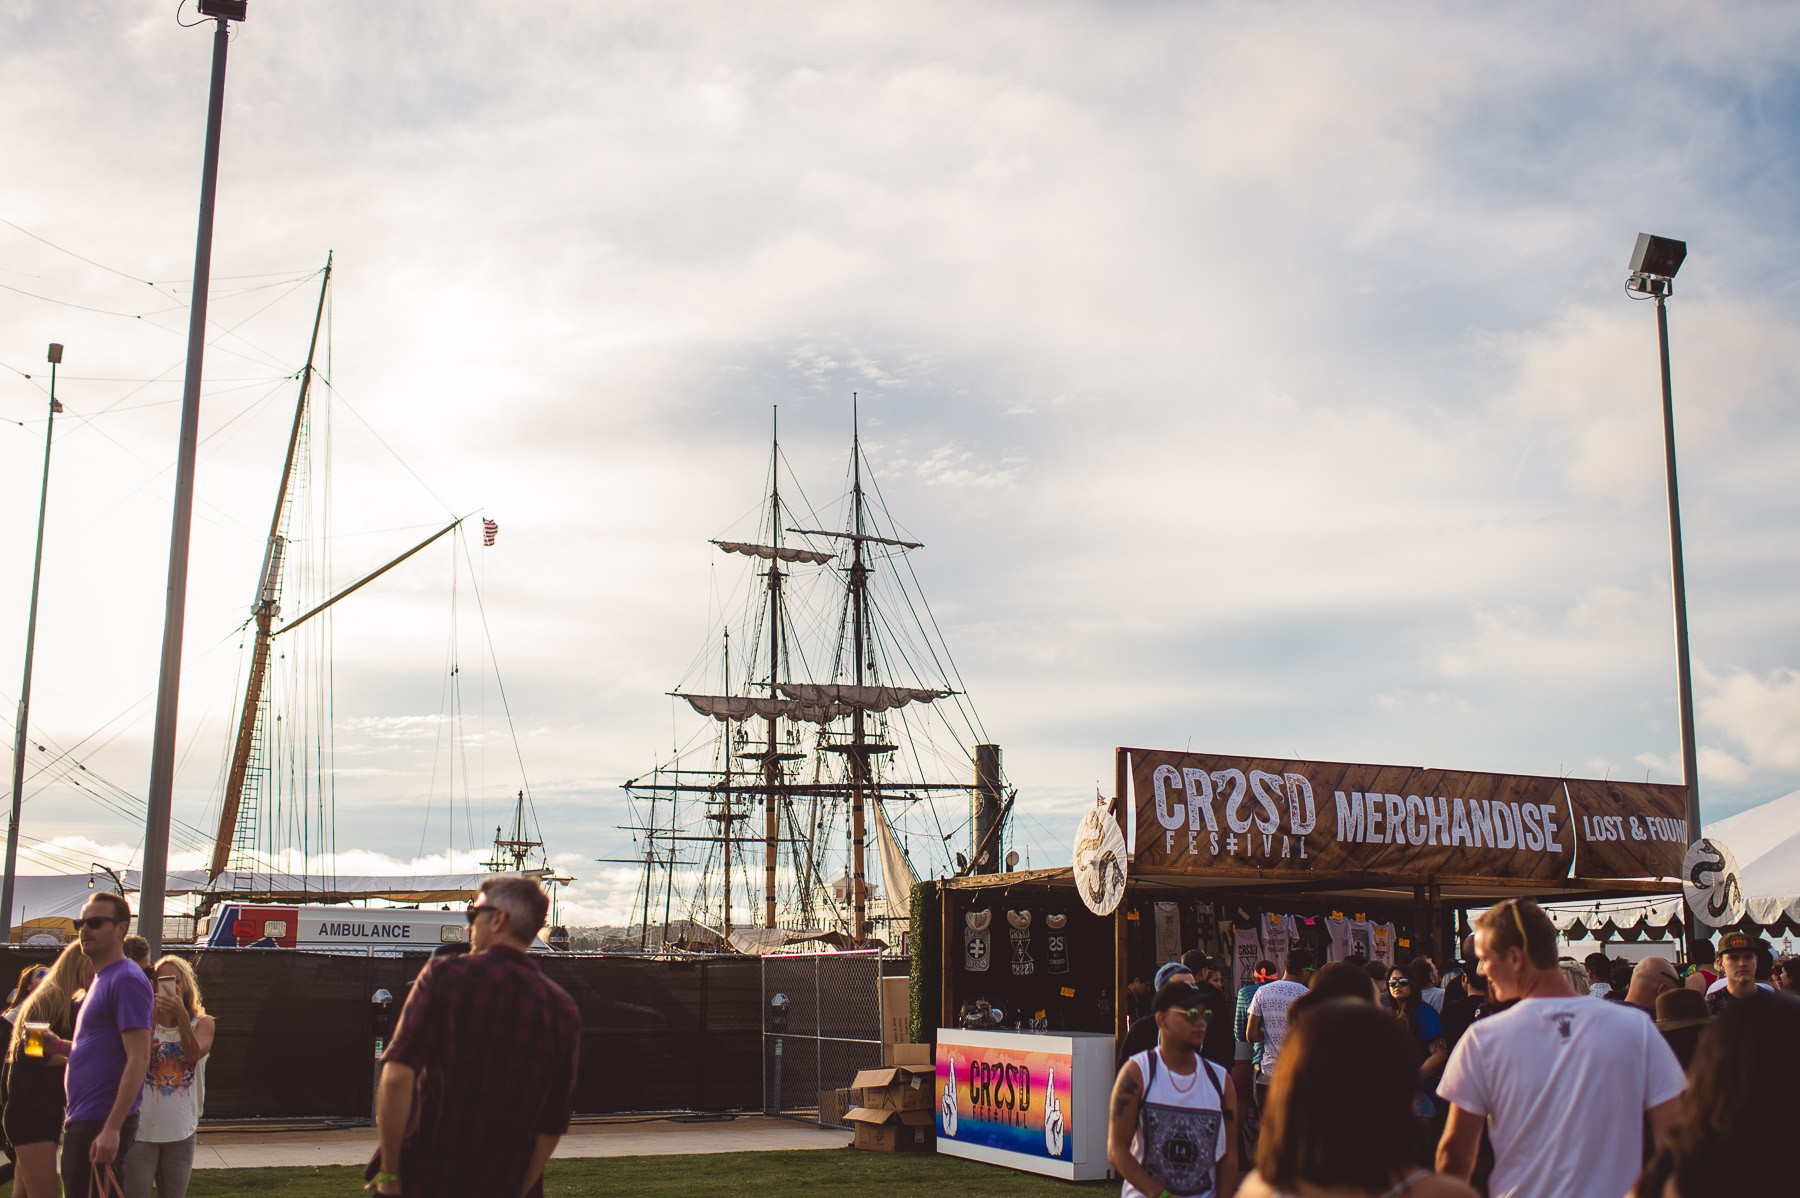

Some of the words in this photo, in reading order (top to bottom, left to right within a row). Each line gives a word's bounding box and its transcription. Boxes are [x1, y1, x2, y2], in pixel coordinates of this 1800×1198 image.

[1334, 790, 1563, 853] MERCHANDISE
[1582, 815, 1625, 842] LOST
[1628, 815, 1647, 841] &
[318, 922, 411, 938] AMBULANCE
